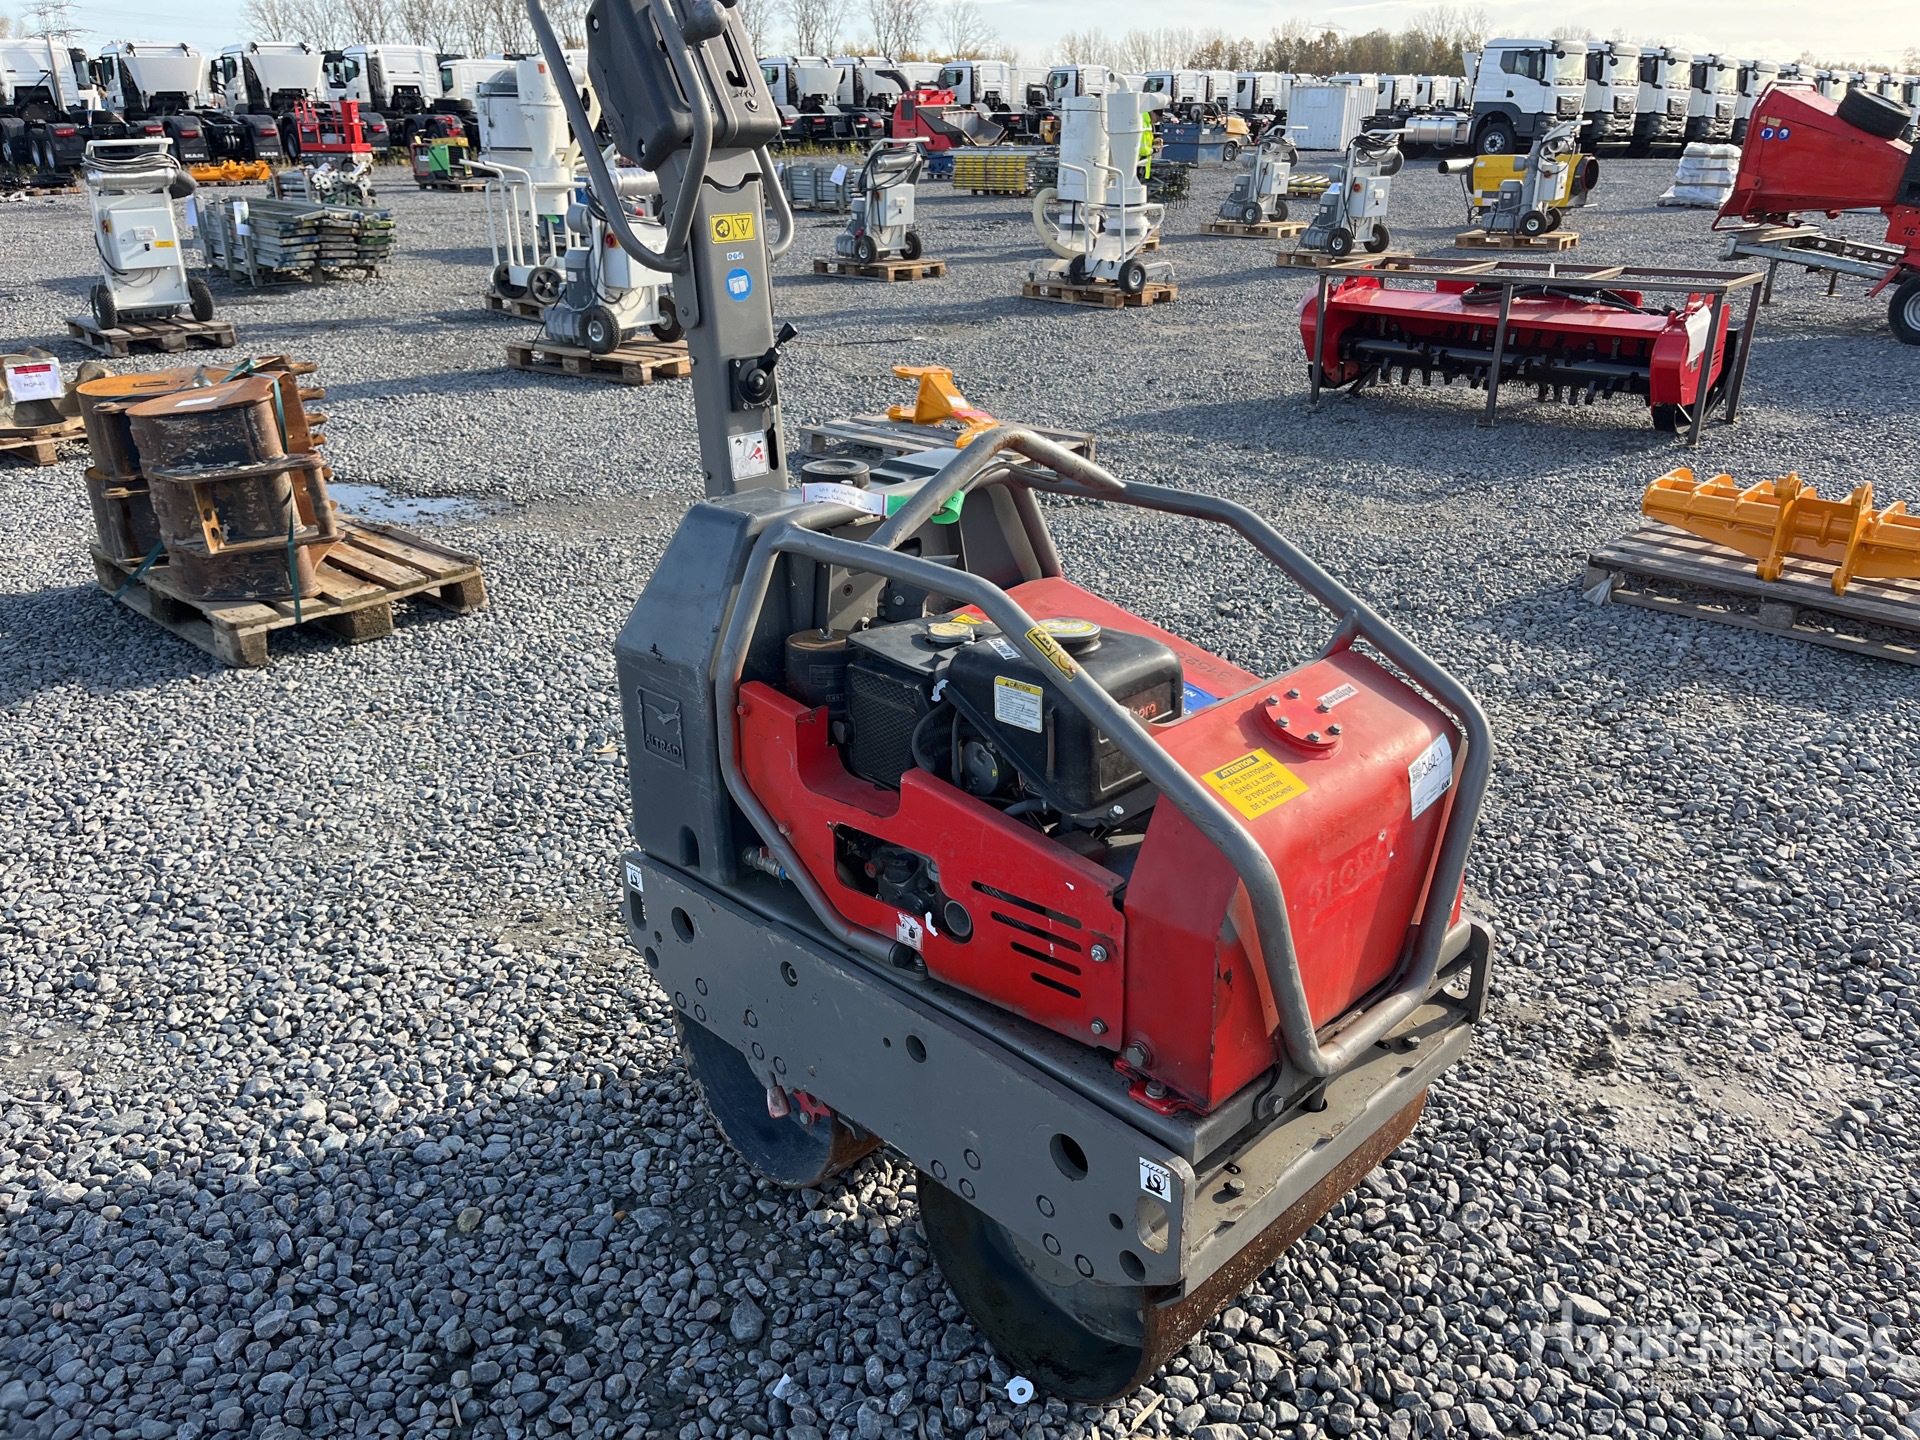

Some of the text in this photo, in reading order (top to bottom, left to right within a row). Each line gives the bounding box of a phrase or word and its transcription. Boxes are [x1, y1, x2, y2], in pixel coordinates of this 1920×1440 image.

[645, 733, 682, 757] ALTRAD
[1219, 757, 1256, 778] ATTENTION
[1219, 761, 1274, 791] NE PAS STATIONNER
[1234, 771, 1277, 795] DANS LA ZONE
[1245, 779, 1284, 801] D'EVOLUTION
[1250, 785, 1295, 811] DE LA MACHINE
